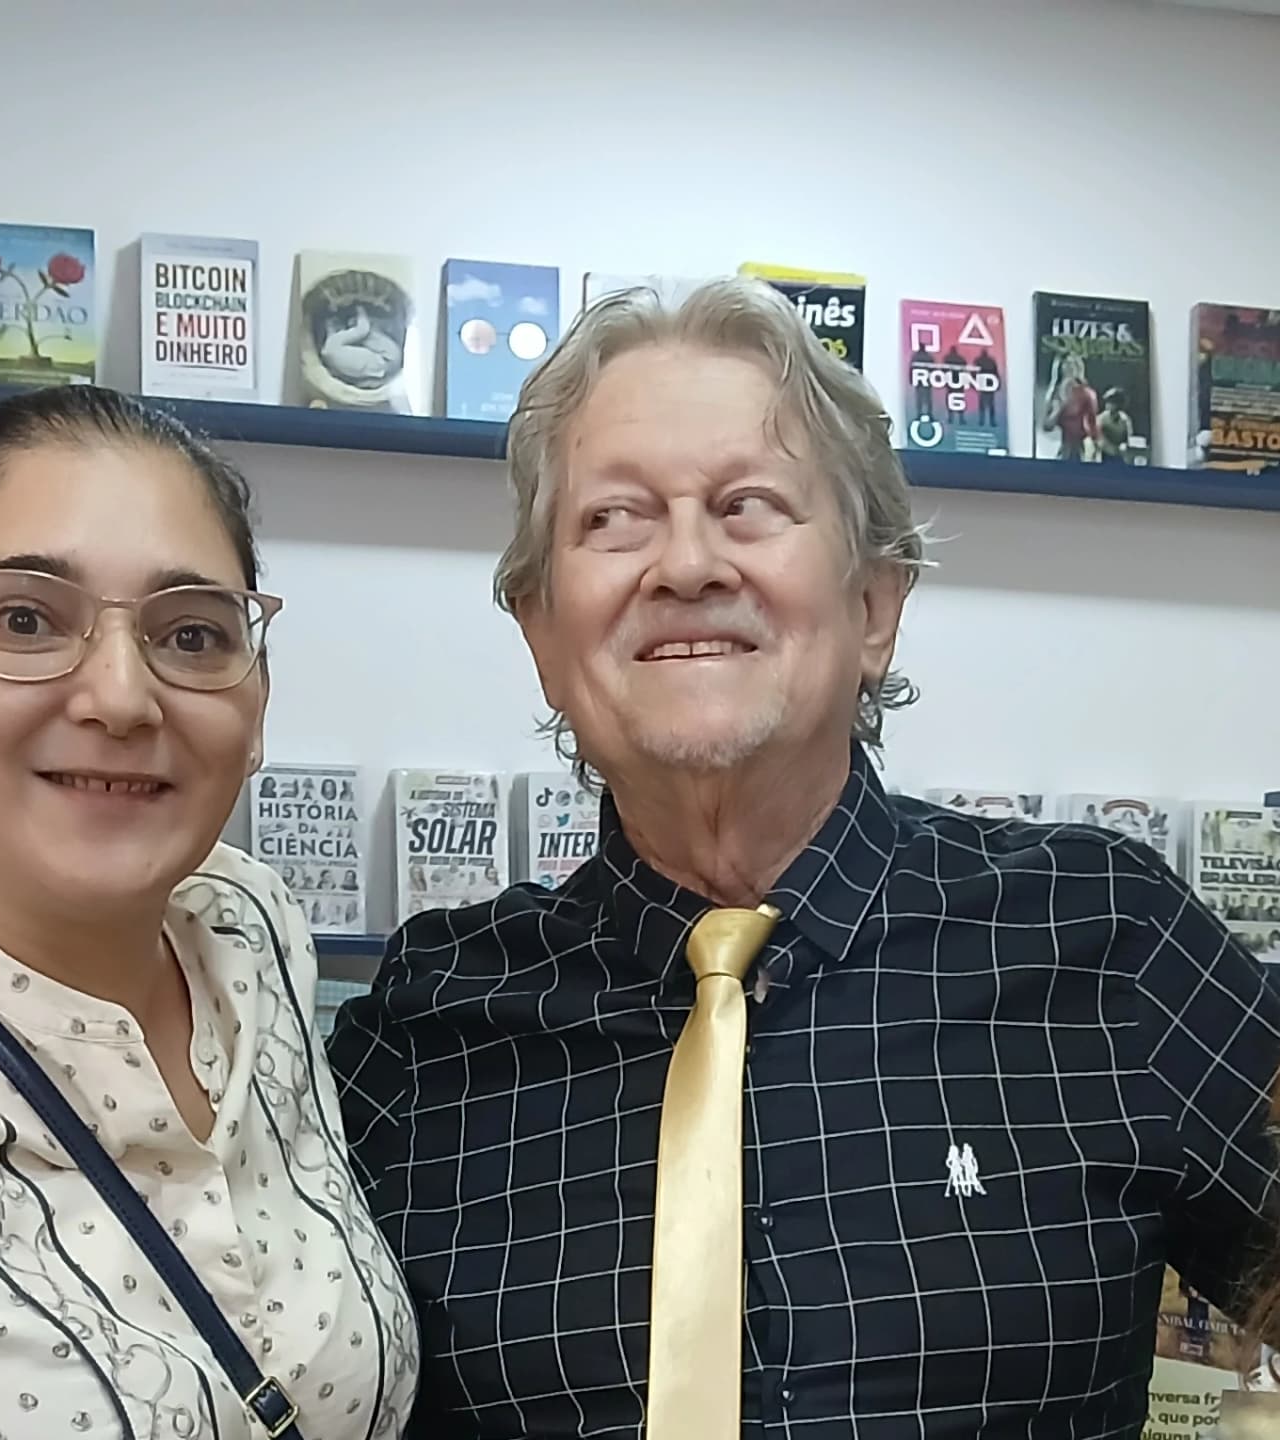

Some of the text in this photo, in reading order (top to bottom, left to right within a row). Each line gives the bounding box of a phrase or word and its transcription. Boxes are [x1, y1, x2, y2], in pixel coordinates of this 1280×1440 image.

[155, 262, 247, 294] BITCOIN
[155, 291, 247, 313] BLOCKCHAIN
[156, 311, 246, 341] E MUITO
[155, 339, 248, 367] DINHEIRO
[911, 368, 1000, 392] ROUND
[947, 392, 967, 411] 6
[259, 799, 359, 822] HISTÓRIA
[441, 801, 496, 819] SISTEMA
[298, 822, 319, 835] DA
[408, 817, 498, 856] SOLAR
[260, 832, 359, 859] CIÊNCIA
[1158, 1412, 1189, 1427] que
